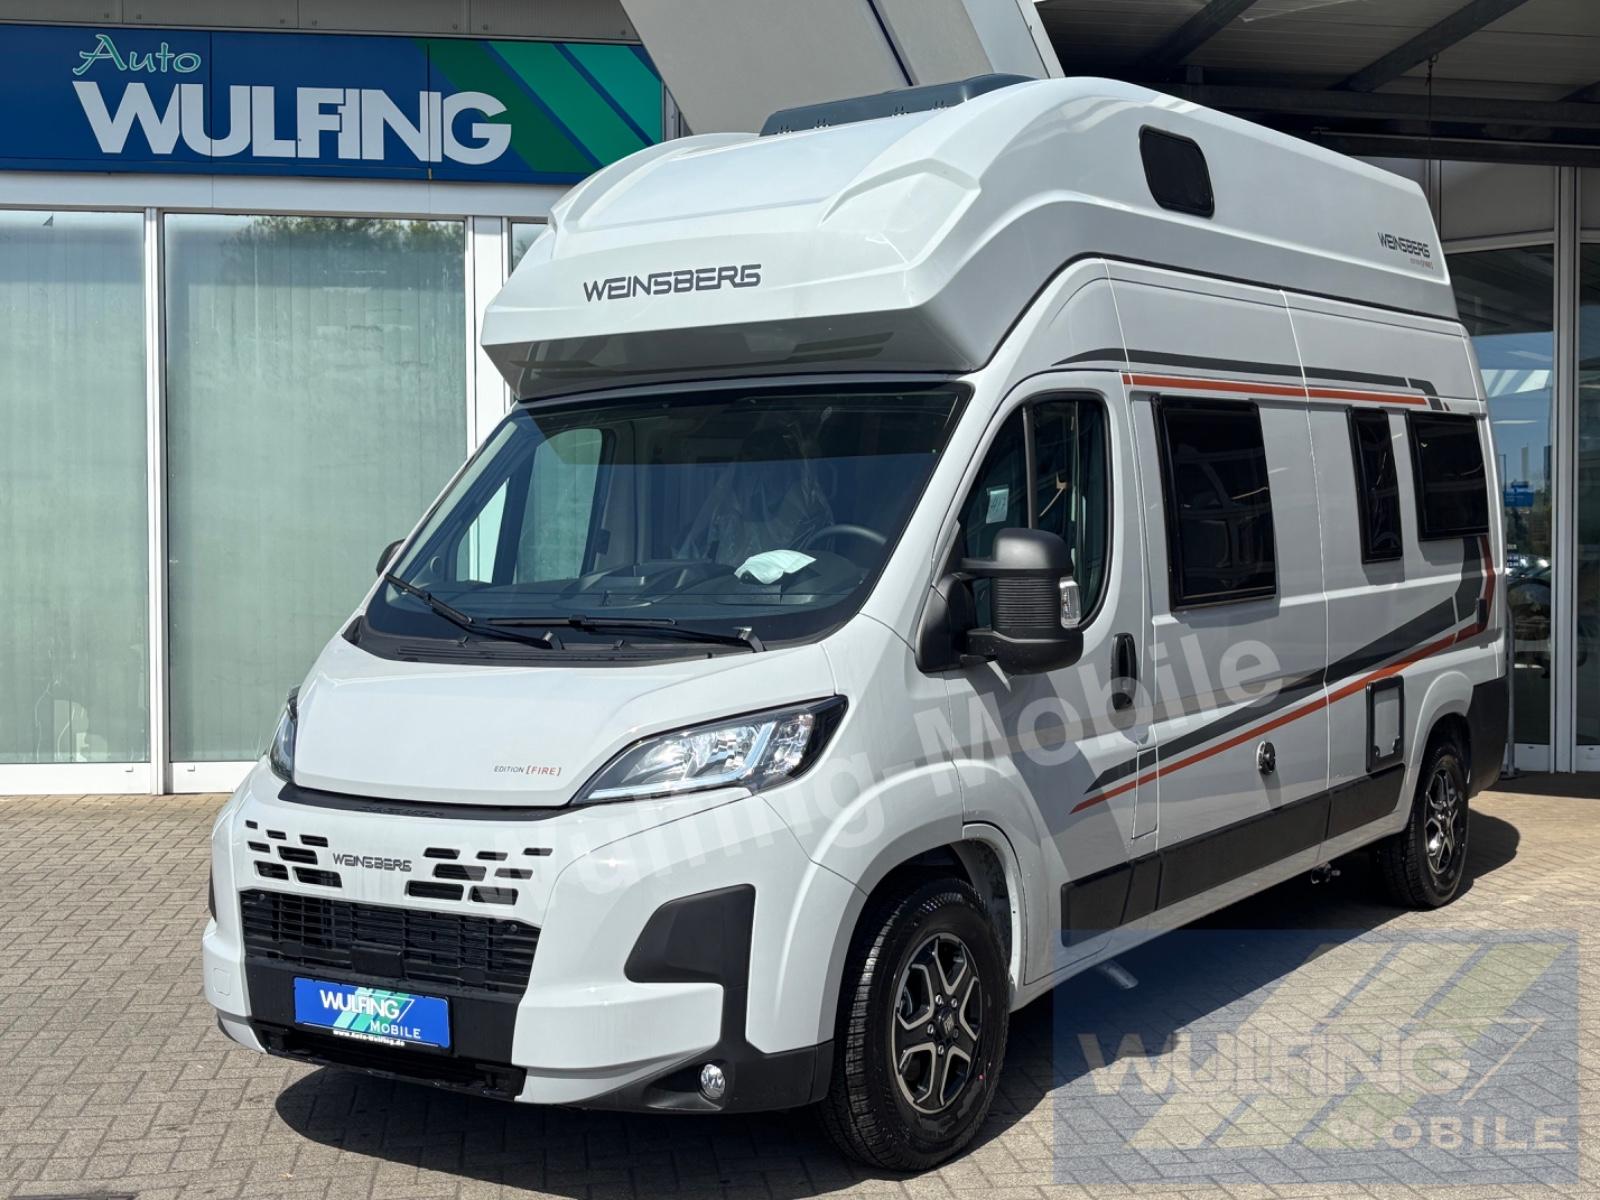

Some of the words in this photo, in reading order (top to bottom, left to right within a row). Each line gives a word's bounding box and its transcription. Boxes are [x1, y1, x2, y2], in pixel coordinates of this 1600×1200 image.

[72, 34, 201, 75] Auto
[72, 81, 512, 165] WULFING
[1377, 231, 1431, 258] WEINSBERG
[583, 264, 762, 302] WEINSBERG
[494, 765, 525, 773] EDITION
[332, 852, 412, 872] WEINSBERG
[320, 989, 399, 1019] WULFING
[369, 1019, 421, 1039] MOBILE
